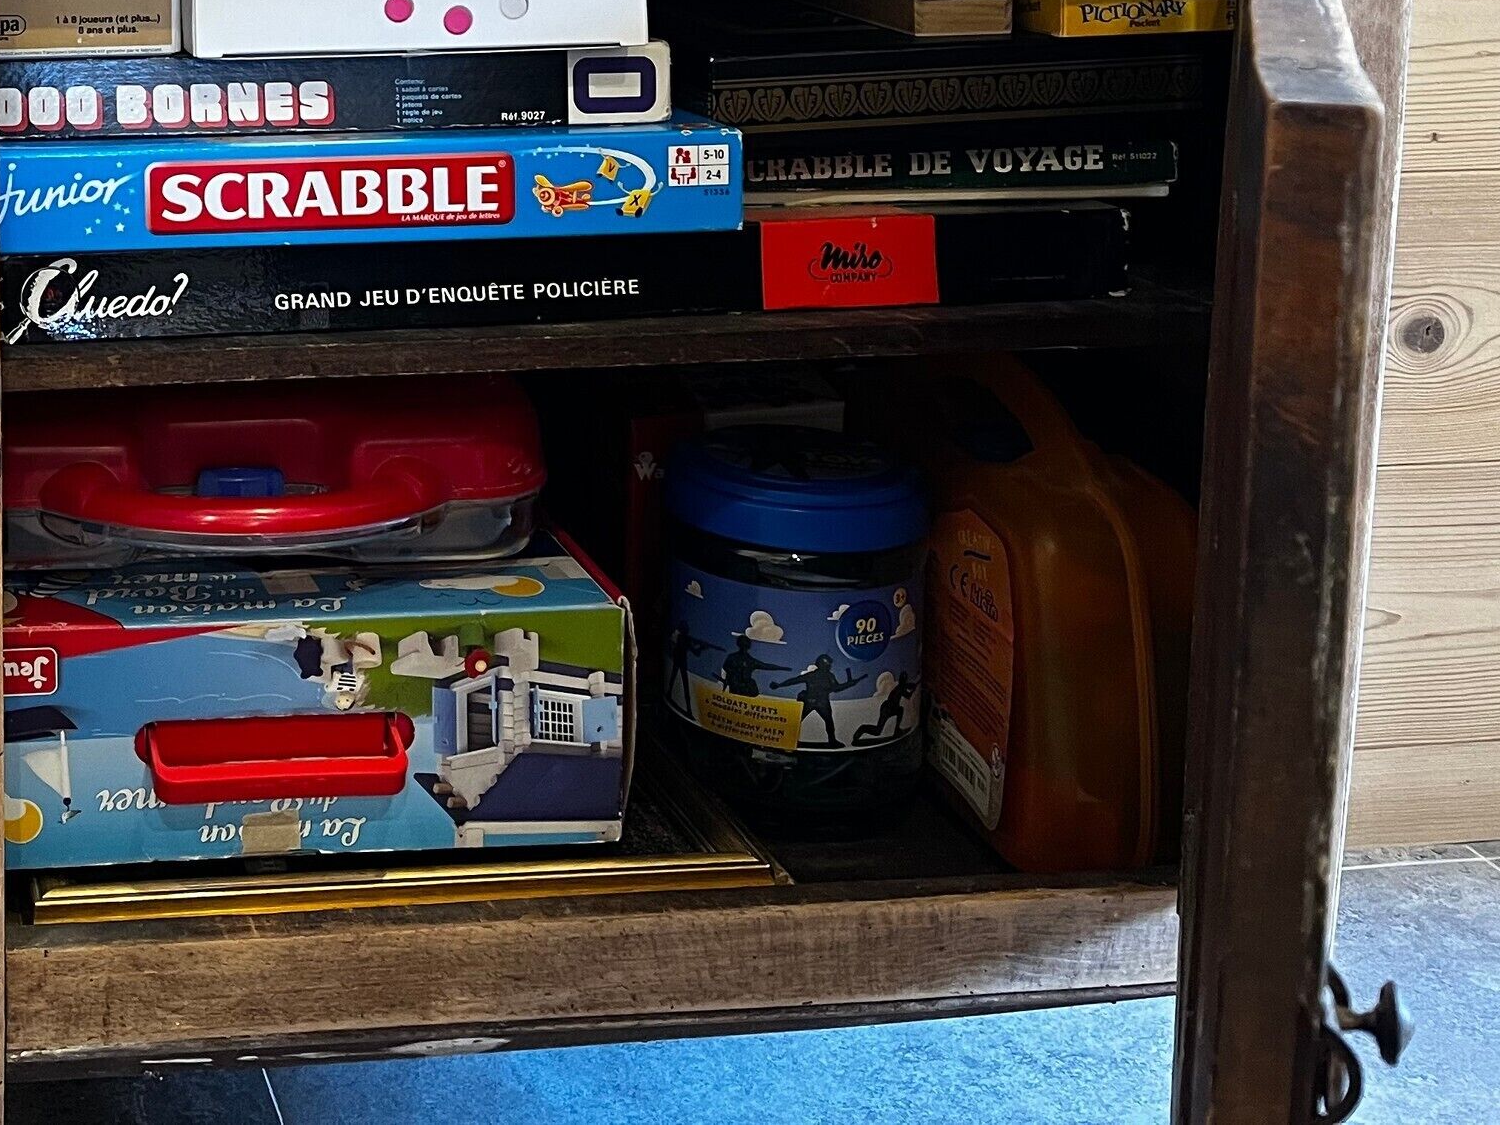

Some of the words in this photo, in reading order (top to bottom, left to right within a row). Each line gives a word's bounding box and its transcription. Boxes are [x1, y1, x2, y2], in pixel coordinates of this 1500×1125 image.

[55, 16, 60, 24] 1
[62, 15, 69, 24] à
[71, 15, 77, 24] 8
[79, 15, 113, 25] joueurs
[115, 14, 129, 25] (et
[1129, 18, 1161, 28] Pocket
[86, 26, 103, 34] ans
[105, 25, 115, 34] et
[117, 25, 139, 35] plus.
[116, 80, 335, 131] BORNES
[431, 108, 443, 117] jeu
[703, 149, 725, 161] 5-10
[909, 151, 951, 176] DE
[966, 145, 1104, 174] VOYAGE
[706, 169, 722, 181] 2-4
[161, 165, 499, 223] SCRABBLE
[630, 193, 641, 207] X
[401, 214, 411, 222] LA
[412, 213, 445, 222] MARQUE
[446, 213, 455, 221] de
[456, 212, 468, 222] jeu
[468, 212, 478, 220] de
[26, 257, 190, 324] Cluedo?
[274, 291, 351, 311] GRAND
[360, 289, 399, 308] JEU
[406, 283, 525, 306] D'ENQUÊTE
[533, 277, 640, 300] POLICIÈRE
[129, 597, 276, 615] maison
[292, 595, 347, 613] La
[855, 617, 877, 634] 90
[846, 632, 884, 646] PIECES
[3, 656, 50, 689] Jeu
[736, 720, 760, 732] ARMY
[763, 726, 785, 736] MEN
[319, 815, 367, 847] La
